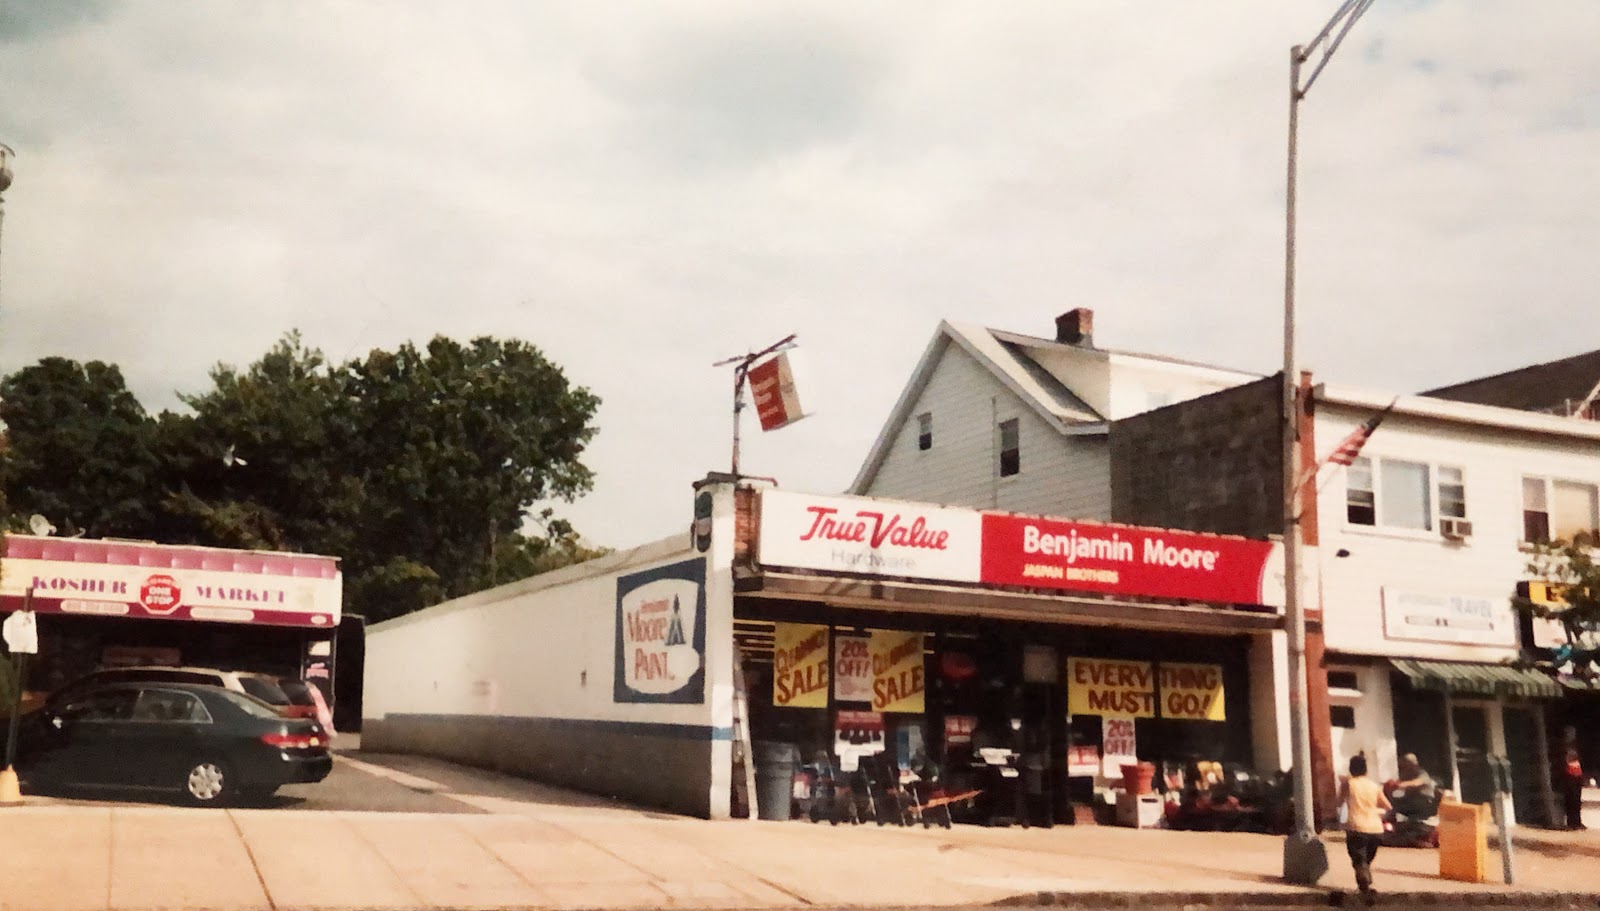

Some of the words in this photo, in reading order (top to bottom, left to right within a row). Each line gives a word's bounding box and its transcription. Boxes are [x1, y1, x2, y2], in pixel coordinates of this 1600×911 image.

[799, 506, 865, 541] True
[856, 511, 949, 550] Value
[1023, 525, 1134, 563] Benjamin
[831, 548, 917, 569] Hardware
[1066, 567, 1119, 584] BROTHERS
[32, 576, 127, 595] KOSHER
[196, 585, 285, 603] MARKET
[145, 595, 174, 605] STOP
[149, 586, 171, 595] ONE
[837, 658, 871, 678] OFF!
[776, 660, 828, 704] SALE
[872, 665, 923, 708] SALE
[1088, 690, 1155, 713] MUST
[1167, 692, 1212, 716] GO!
